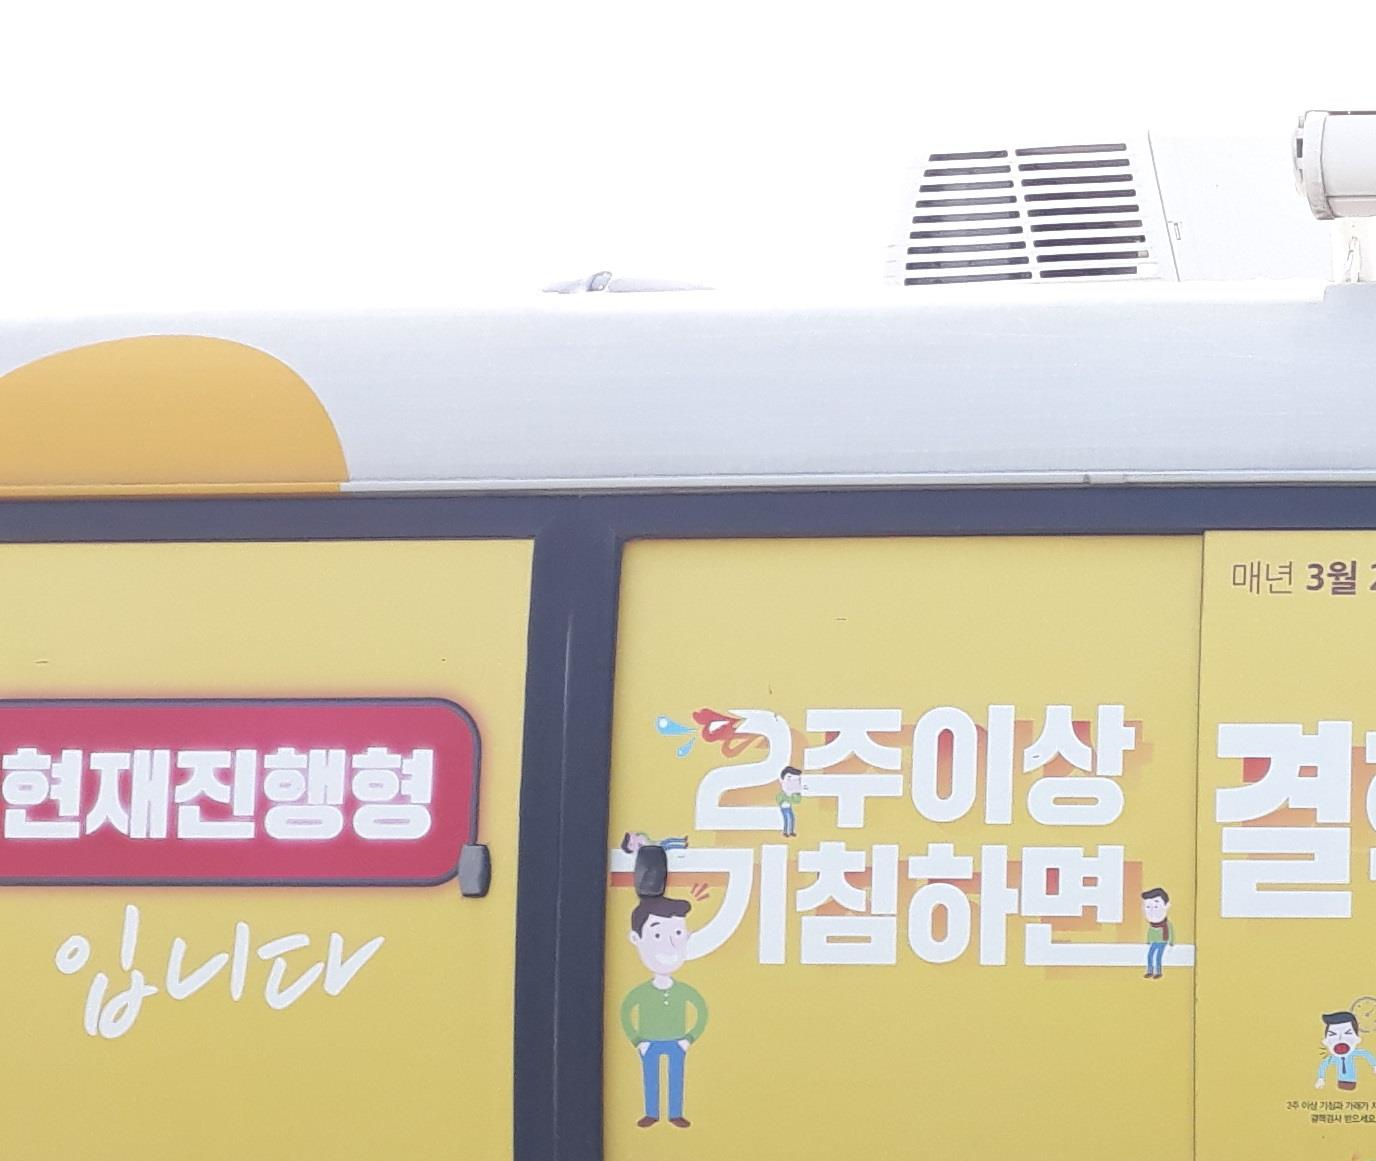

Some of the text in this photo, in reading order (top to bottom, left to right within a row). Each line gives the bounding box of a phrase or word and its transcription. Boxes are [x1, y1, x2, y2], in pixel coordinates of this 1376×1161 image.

[1232, 561, 1294, 594] 매년
[1306, 561, 1357, 595] 3월
[2, 746, 434, 840] 현재진행형
[695, 703, 1135, 831] 2주이상
[611, 841, 1195, 966] 기침하면
[55, 904, 385, 1038] 입니다
